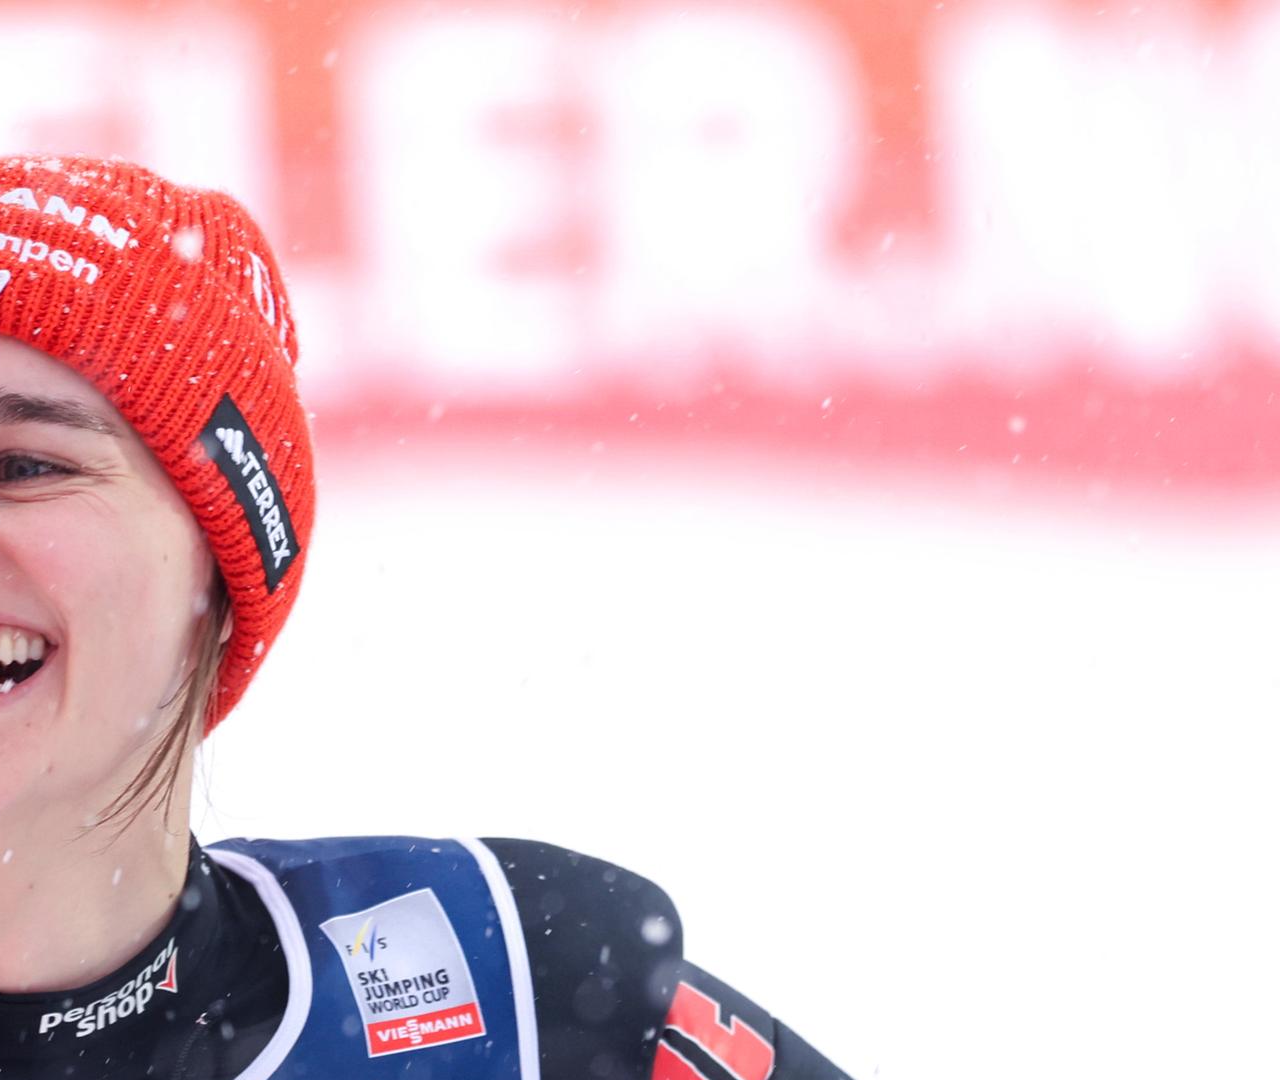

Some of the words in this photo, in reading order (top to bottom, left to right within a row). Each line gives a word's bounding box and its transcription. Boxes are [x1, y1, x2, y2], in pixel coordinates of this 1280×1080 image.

[241, 450, 291, 570] TERREX
[345, 936, 388, 956] FIS
[39, 936, 176, 1034] personal
[357, 967, 389, 986] SKI
[364, 968, 451, 1002] JUMPING
[75, 981, 154, 1038] shop
[368, 994, 420, 1015] WORLD
[422, 986, 451, 1004] CUP
[376, 1012, 474, 1045] VIESSMANN
